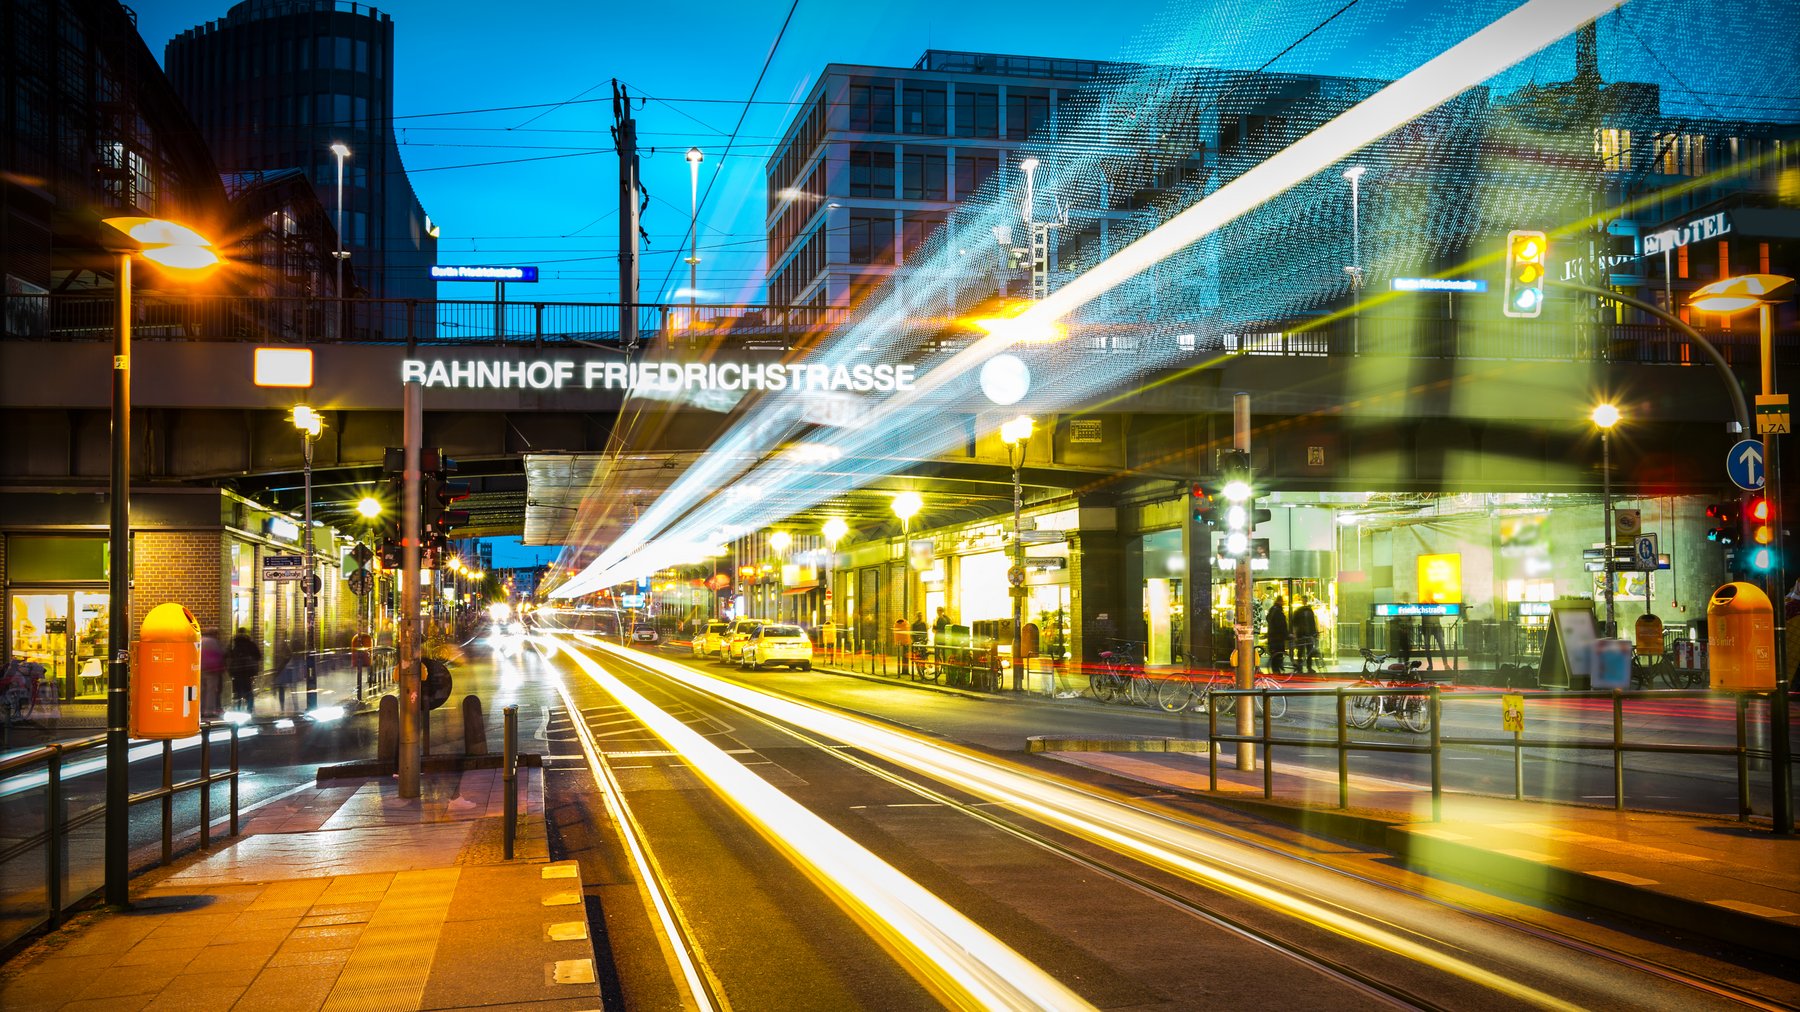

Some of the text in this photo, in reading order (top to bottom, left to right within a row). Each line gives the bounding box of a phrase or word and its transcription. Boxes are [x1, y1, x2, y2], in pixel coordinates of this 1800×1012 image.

[402, 360, 916, 391] BAHNHOF FRIEDRICHSTRASSE
[1760, 423, 1787, 434] LZA
[1398, 604, 1447, 615] Friedrichstraße
